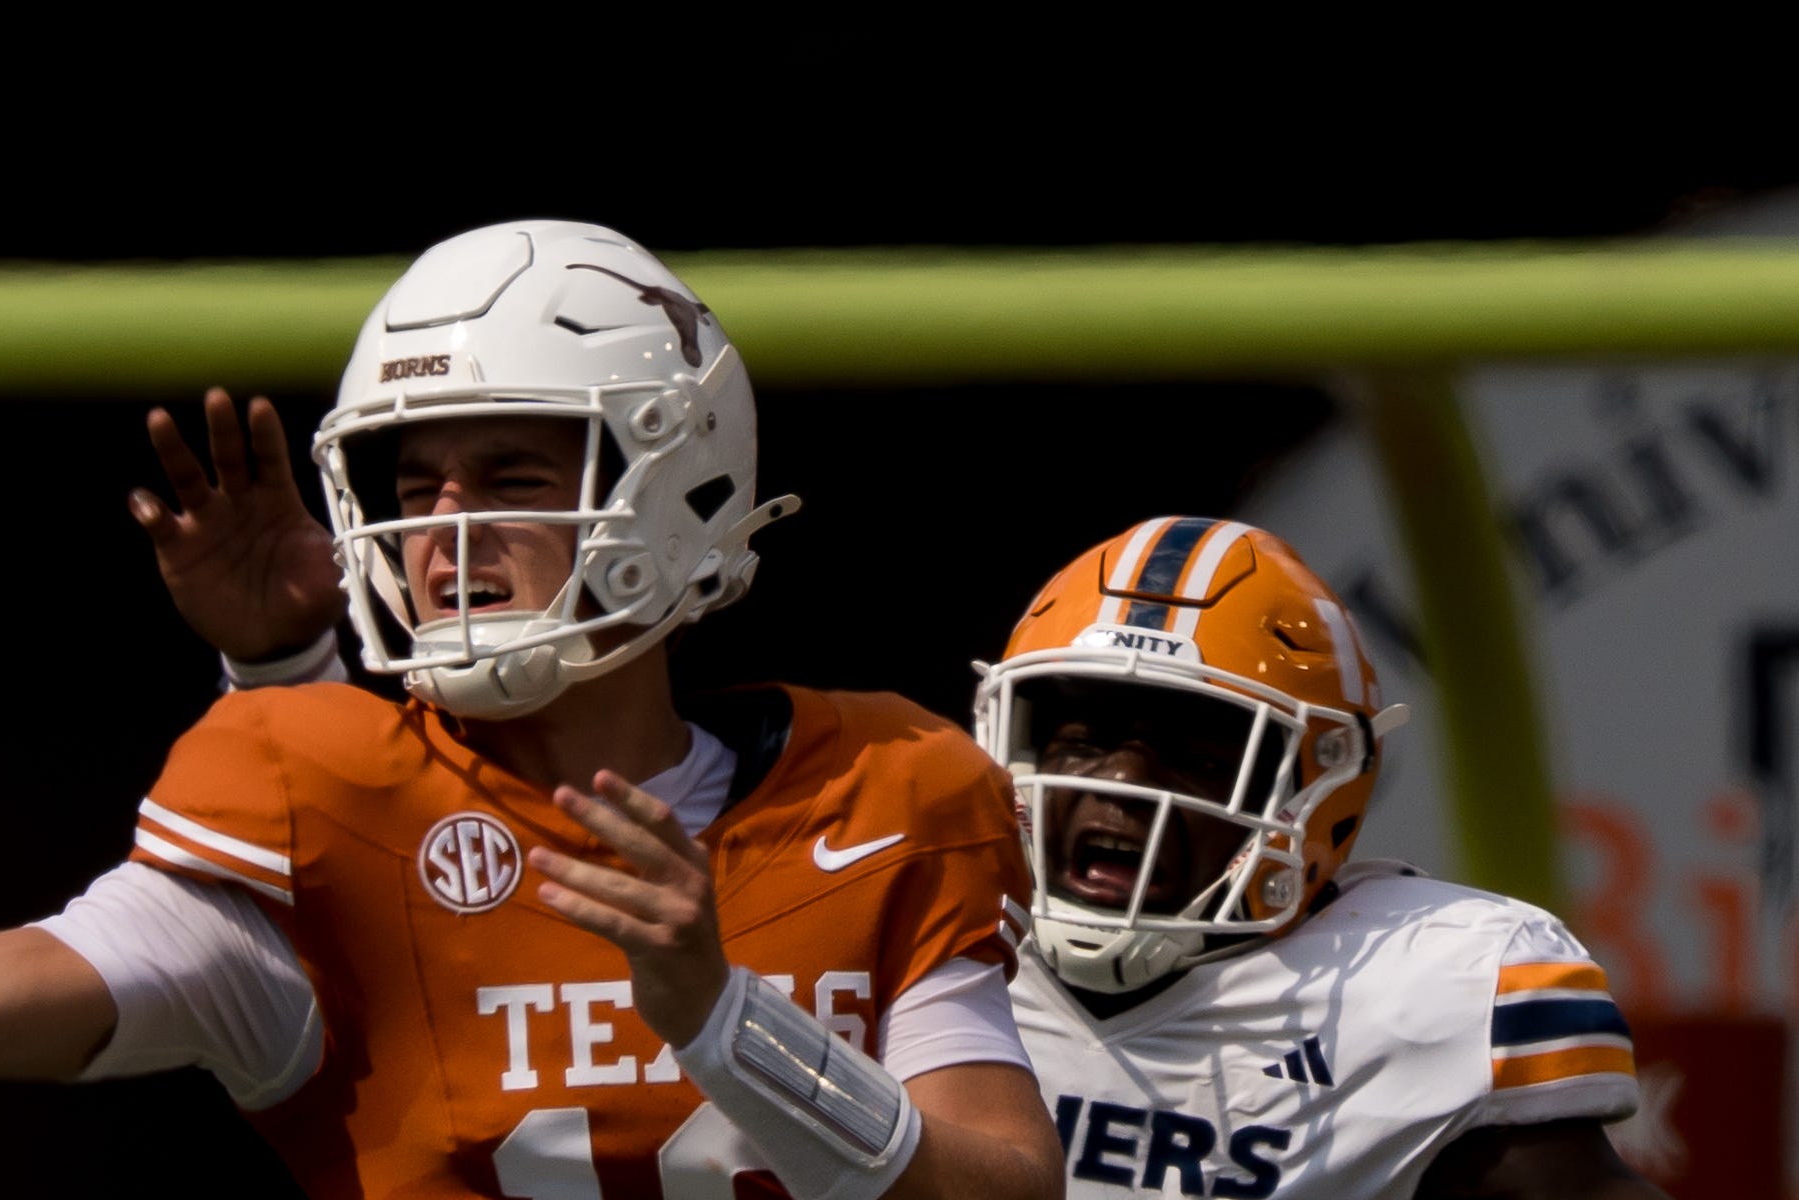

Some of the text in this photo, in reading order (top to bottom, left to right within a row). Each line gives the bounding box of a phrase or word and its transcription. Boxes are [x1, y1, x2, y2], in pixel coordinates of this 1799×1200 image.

[1097, 630, 1182, 656] NITY
[428, 820, 512, 904] SEC
[477, 971, 871, 1090] TES
